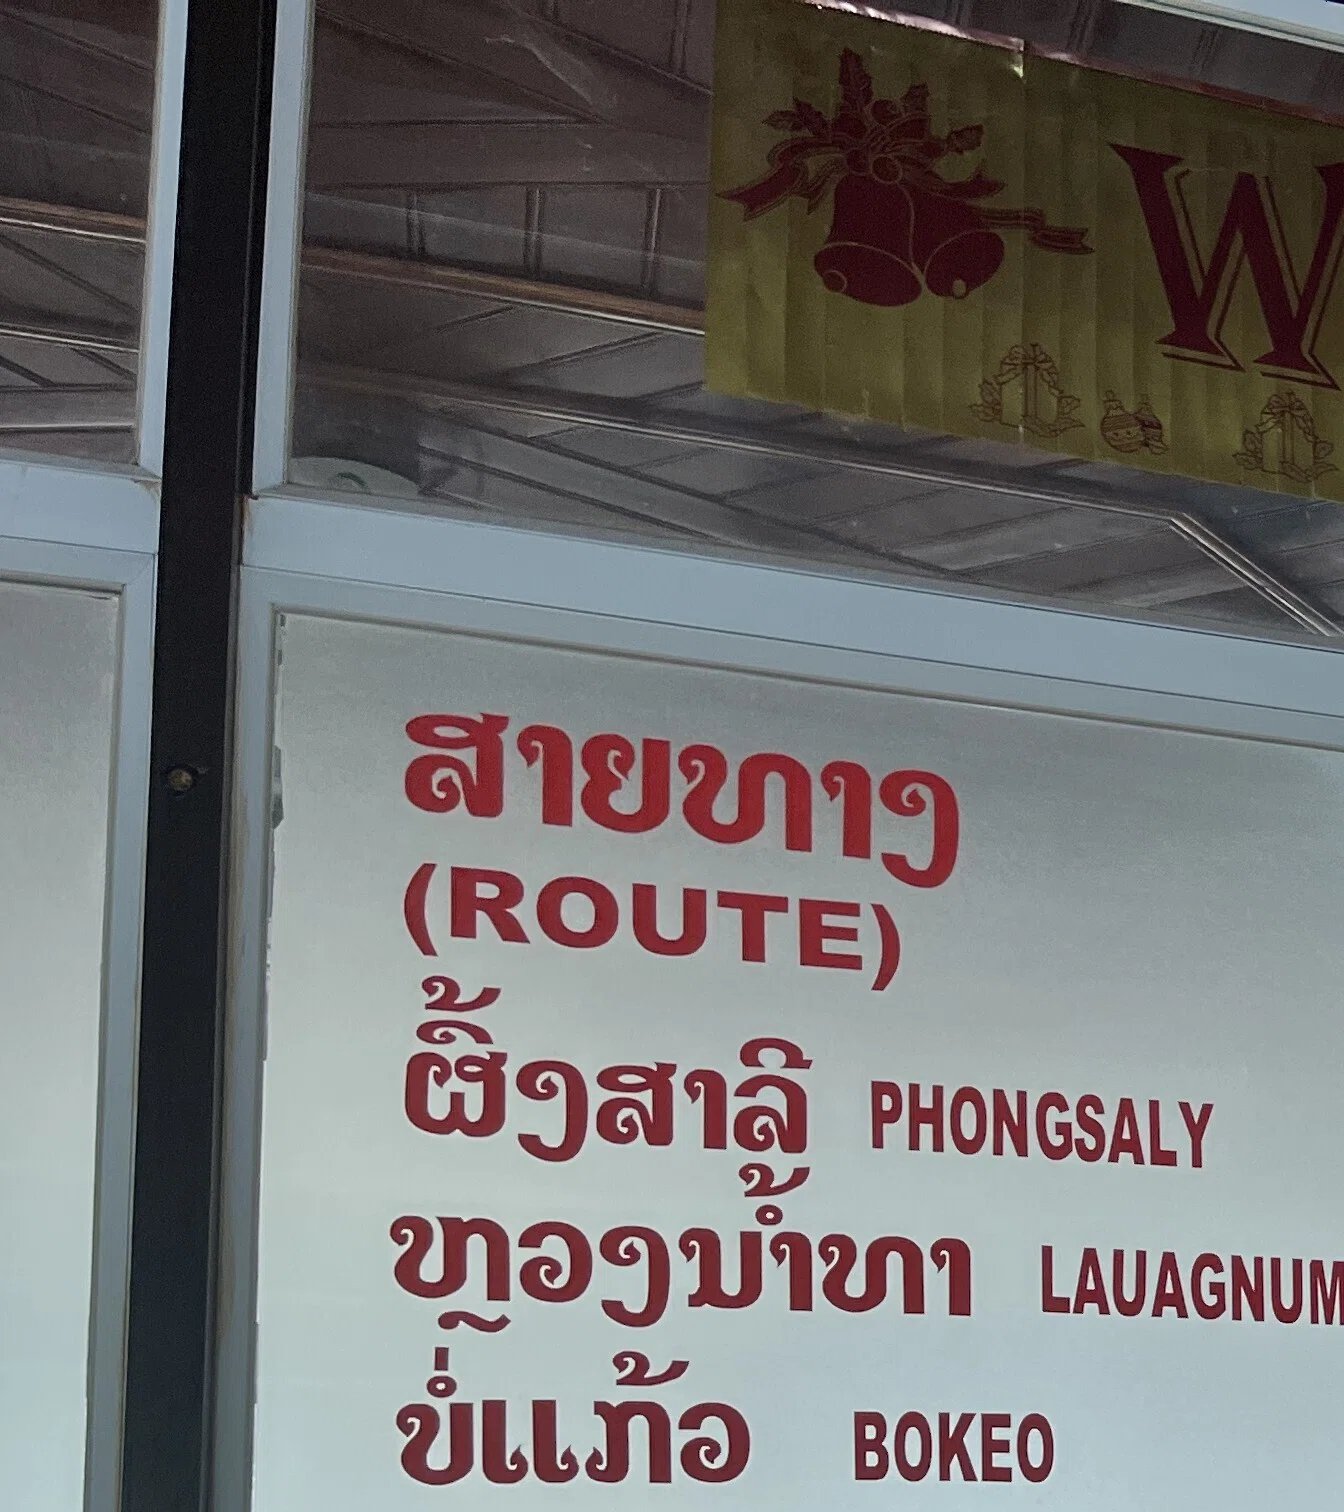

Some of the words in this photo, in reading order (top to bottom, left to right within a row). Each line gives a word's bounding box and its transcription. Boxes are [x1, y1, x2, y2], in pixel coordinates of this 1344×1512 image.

[403, 711, 961, 890] ສາຍທາງ
[402, 861, 903, 992] (ROUTE)
[870, 1079, 1214, 1170] PHONGSALY
[853, 1411, 1055, 1483] BOKEO
